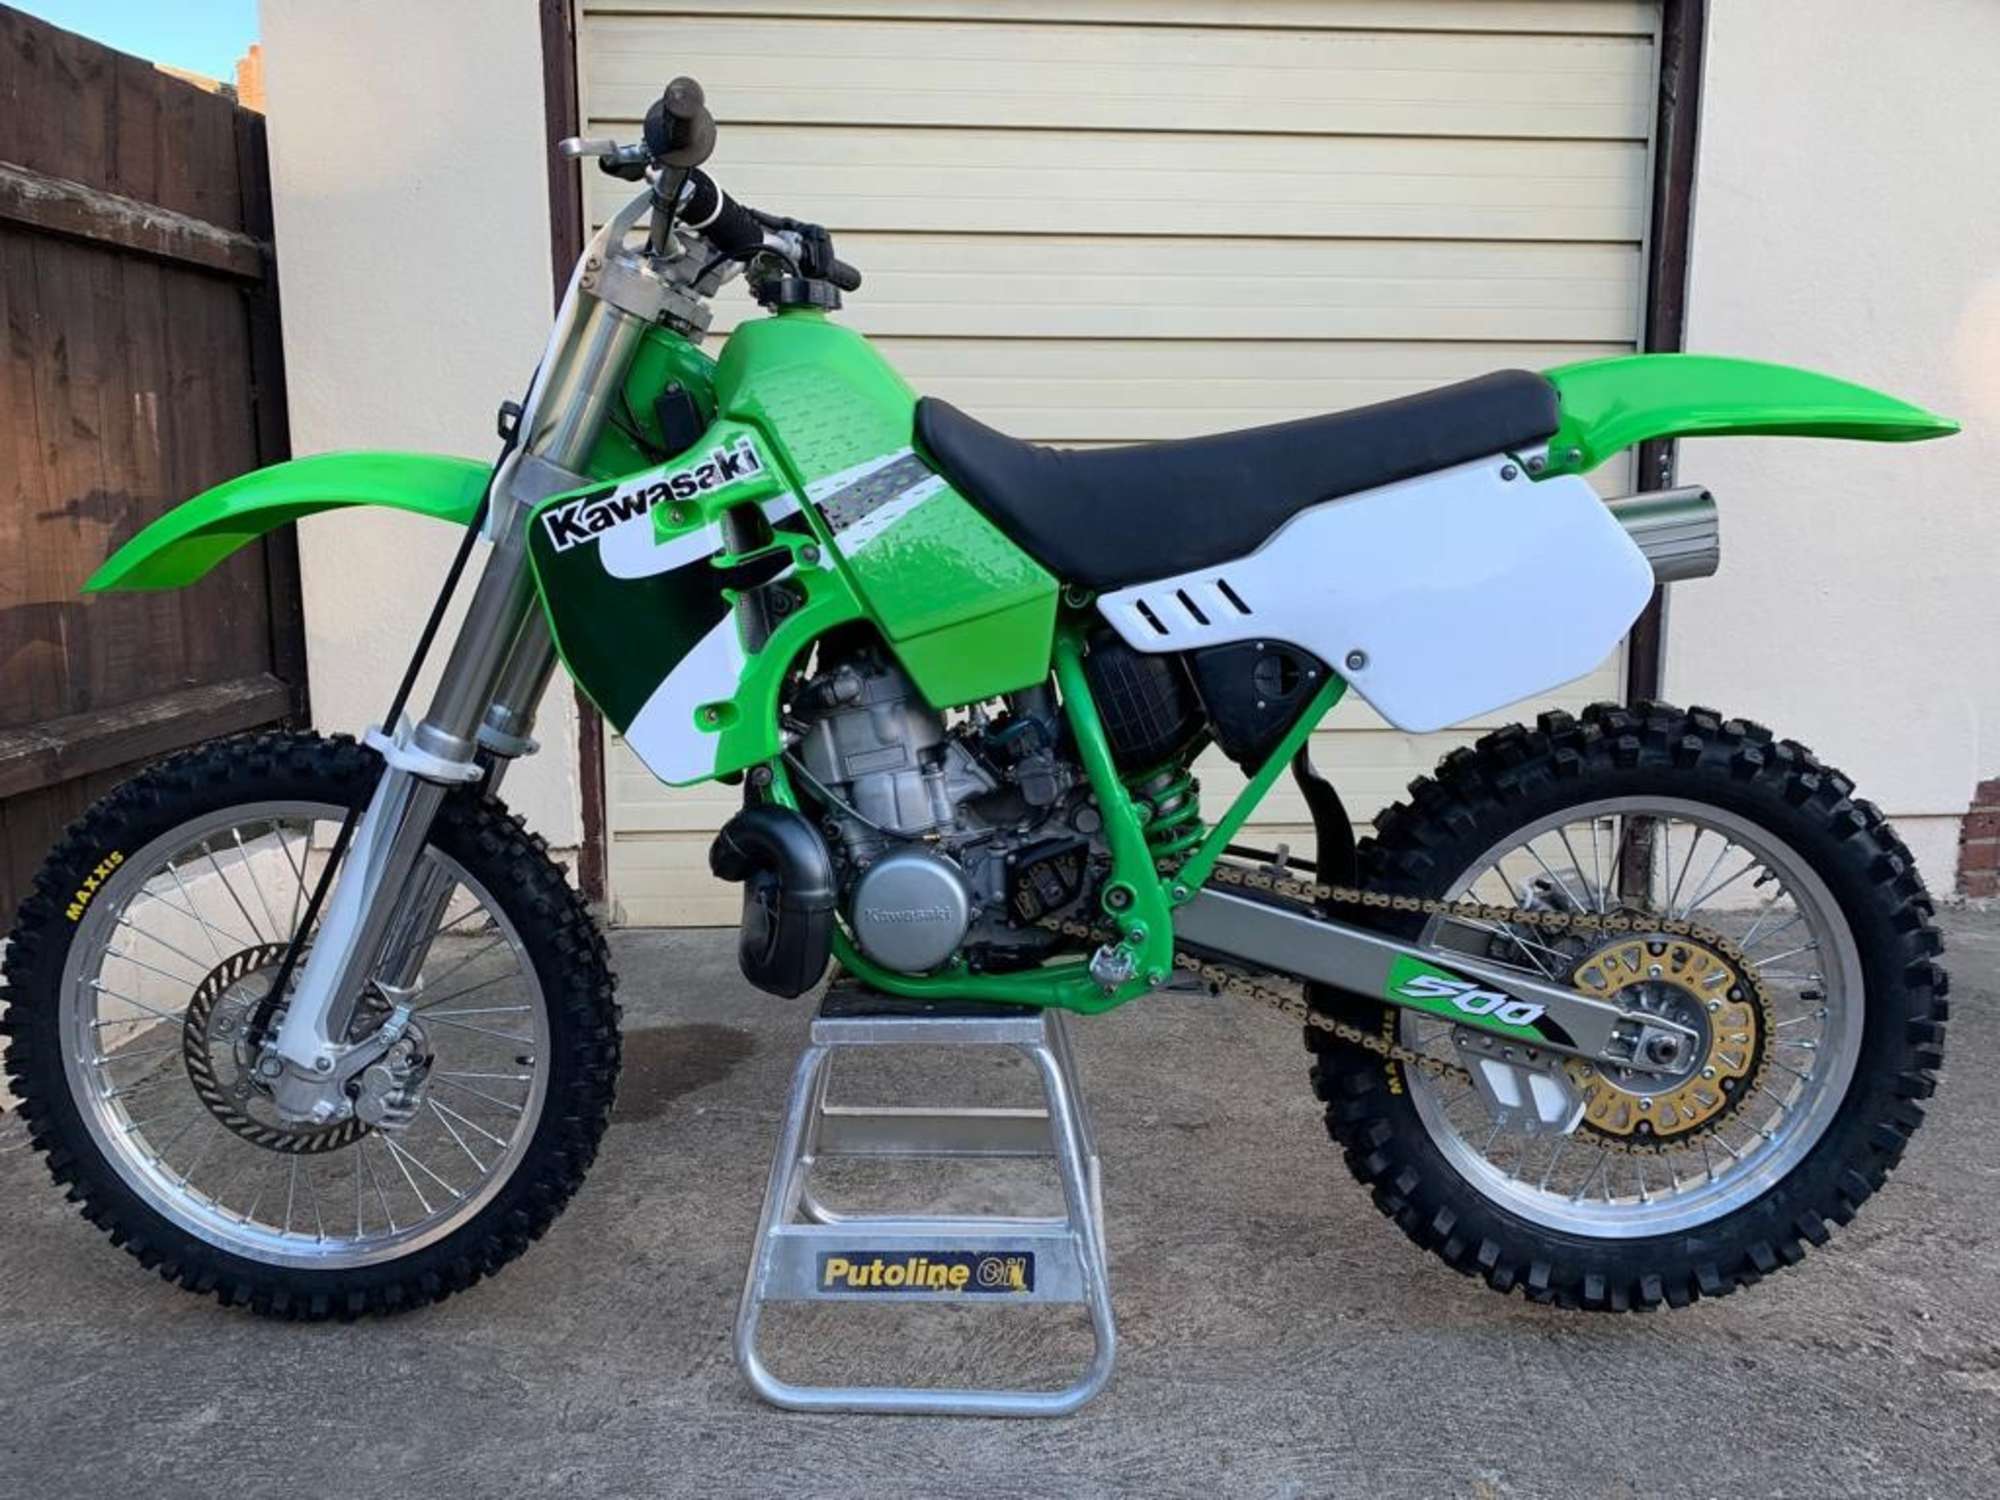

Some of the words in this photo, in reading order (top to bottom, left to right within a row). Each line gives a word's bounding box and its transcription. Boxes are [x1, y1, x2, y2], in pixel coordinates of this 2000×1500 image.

[545, 437, 762, 547] Kawasaki
[66, 850, 124, 921] MAXXIS
[864, 905, 953, 922] Kawasaki
[1393, 974, 1547, 1026] 500
[1382, 1008, 1403, 1095] MAXIS
[824, 1257, 970, 1286] Putoline
